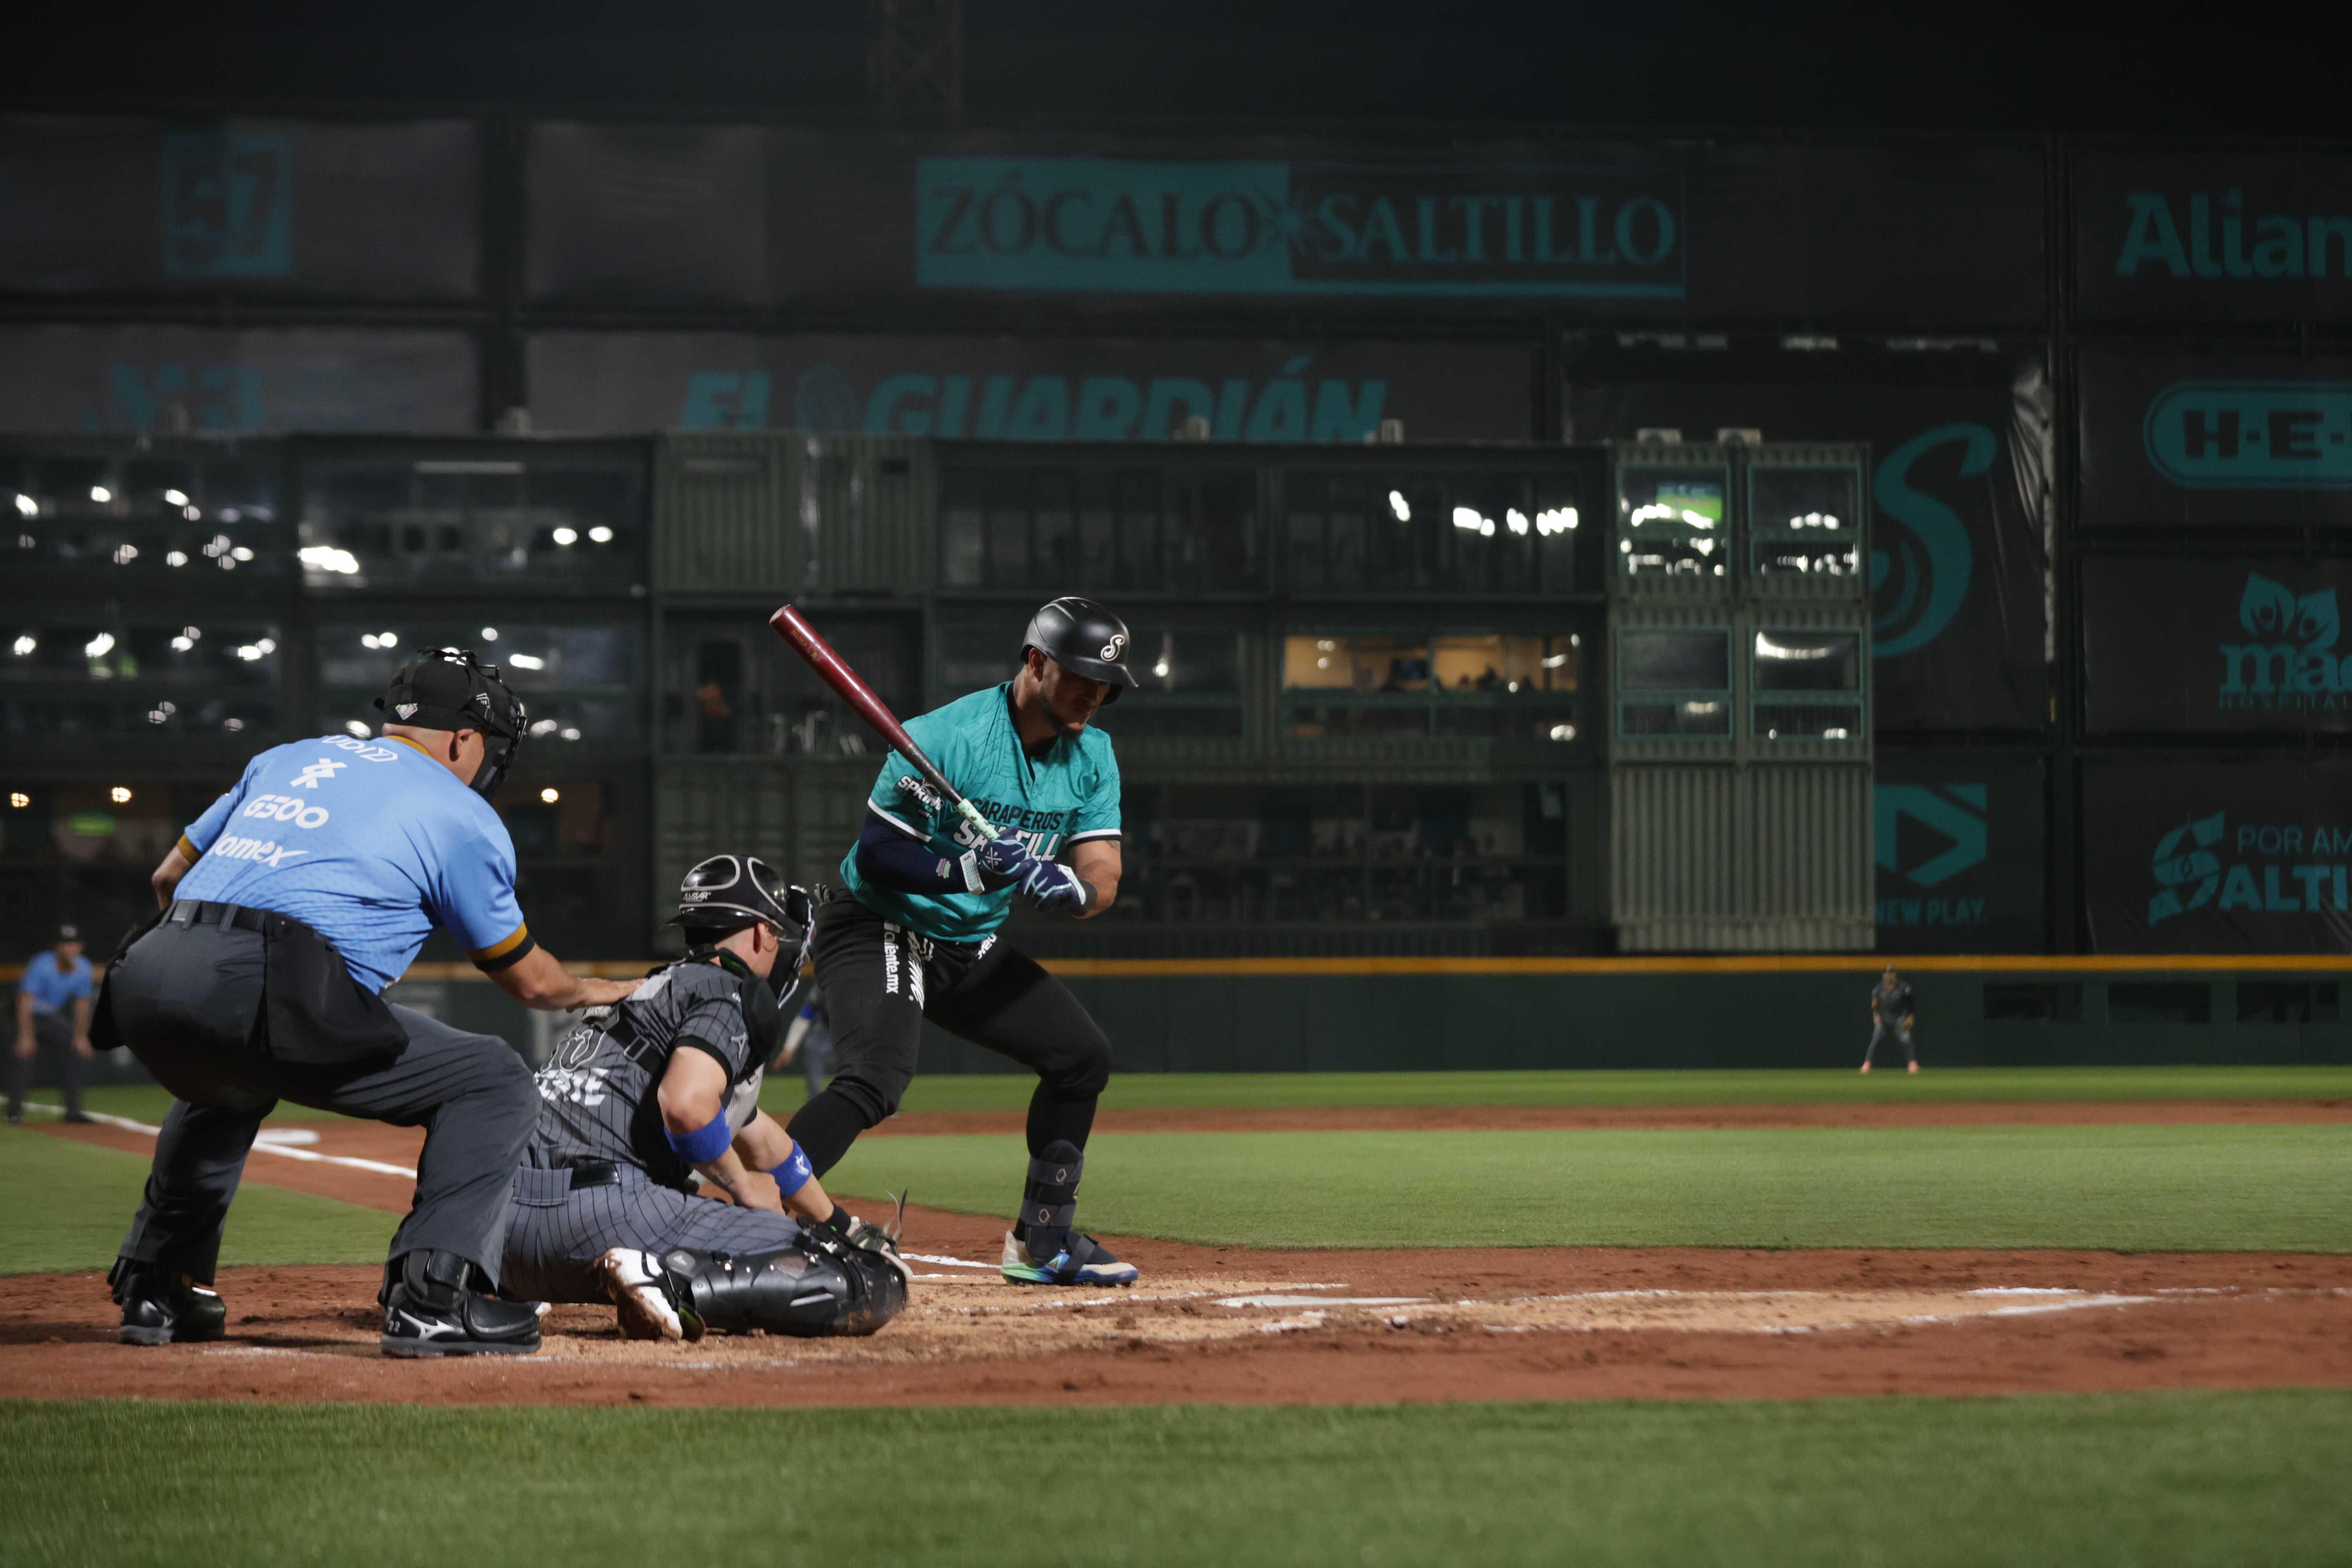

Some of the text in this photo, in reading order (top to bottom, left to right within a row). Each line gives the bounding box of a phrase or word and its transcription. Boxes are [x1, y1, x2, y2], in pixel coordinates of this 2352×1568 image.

[927, 169, 1676, 267] ZÓCALO SALTILLO
[2116, 187, 2352, 279] Alian
[2182, 410, 2352, 459] H-E-
[2218, 642, 2352, 694] ma
[243, 794, 329, 829] G500
[897, 775, 943, 811] SPRING
[2237, 825, 2303, 855] POR
[1925, 896, 1988, 927] PLAY
